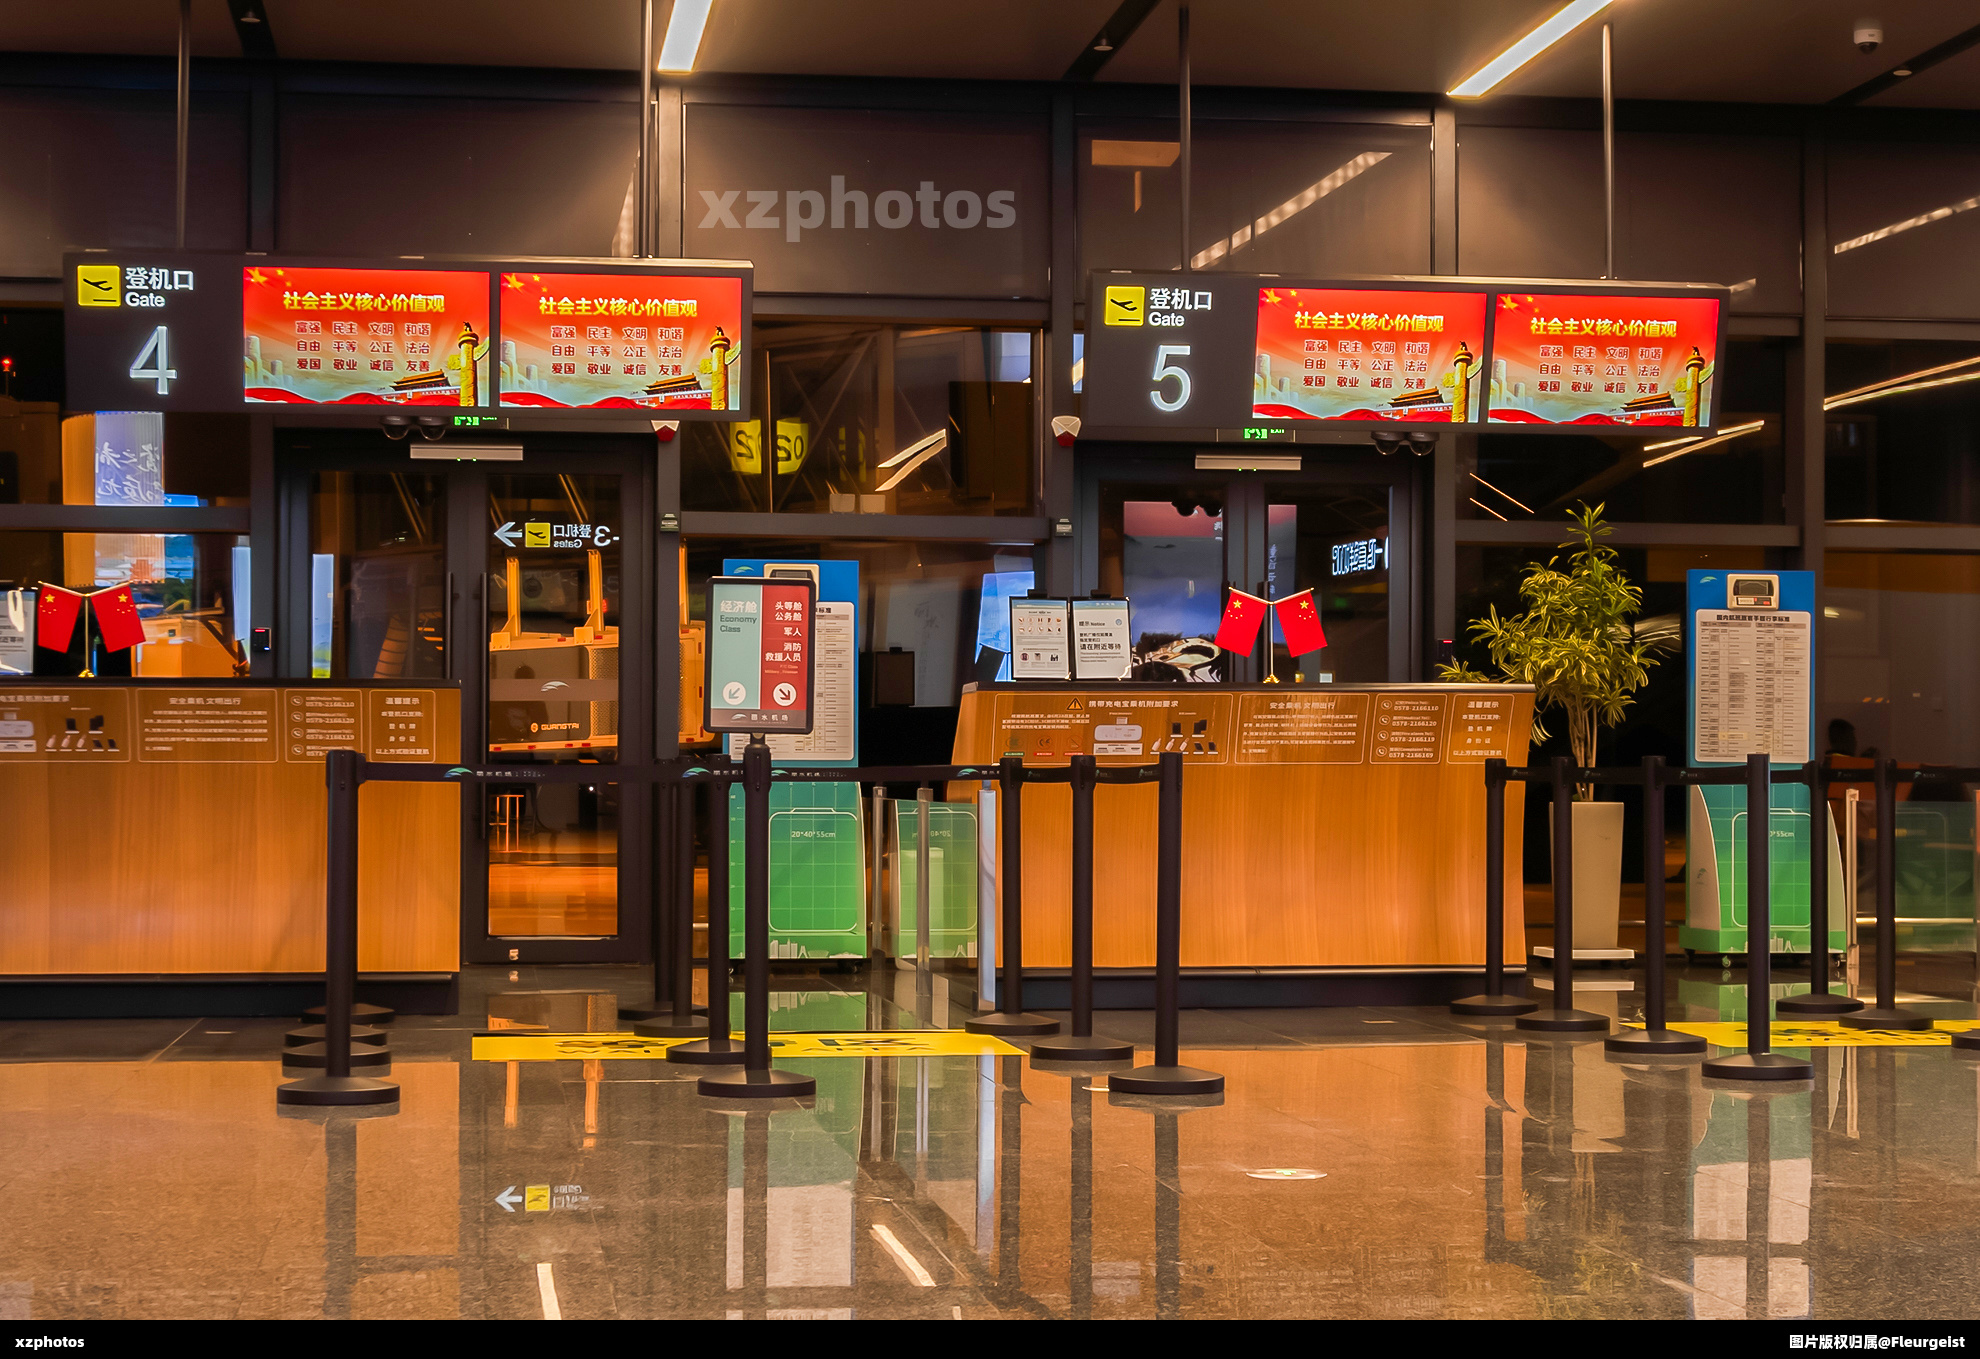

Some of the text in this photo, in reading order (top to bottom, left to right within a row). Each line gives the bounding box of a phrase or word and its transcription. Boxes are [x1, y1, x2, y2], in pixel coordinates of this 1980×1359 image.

[125, 268, 194, 290] 登机口
[125, 292, 166, 307] Gate
[283, 291, 445, 313] 社会主义核心价值观
[1150, 288, 1212, 310] 登机口
[539, 296, 698, 317] 社会主义核心价值观
[1149, 312, 1184, 326] Gate
[1294, 311, 1444, 332] 社会主义核心价值观
[296, 321, 431, 336] 富强 民主 文明 和谐
[550, 326, 683, 341] 富强 民主 文明 和谐
[1531, 317, 1677, 338] 社会主义核心价值观
[296, 340, 430, 354] 自由 平等 公正 法治
[551, 345, 682, 358] 自由 平等 公正 法治
[1305, 340, 1430, 355] 富强 民主 文明 和谐
[1540, 345, 1563, 358] 富强
[1573, 346, 1596, 359] 民主
[1606, 347, 1629, 359] 文明
[130, 326, 177, 394] 4
[296, 358, 430, 372] 爱国 敬业 诚信 友善
[1304, 358, 1428, 372] 自由 平等 公正 法治
[551, 362, 682, 376] 爱国 敬业 诚信 友善
[1539, 363, 1561, 375] 自由
[1605, 365, 1628, 377] 公正
[1638, 365, 1660, 377] 法治
[1150, 345, 1192, 412] 5
[1303, 375, 1426, 390] 爱国 敬业 诚信 友善
[1538, 380, 1560, 393] 爱国
[1571, 381, 1594, 393] 敬业
[1604, 381, 1626, 394] 诚信
[720, 600, 758, 613] 经济舱
[775, 601, 802, 611] 头等舱
[720, 615, 757, 624] Economy
[775, 612, 802, 621] 公务舱
[720, 625, 741, 633] Class
[784, 627, 802, 636] 军人
[784, 643, 801, 651] 消防
[765, 652, 801, 662] 救援人员
